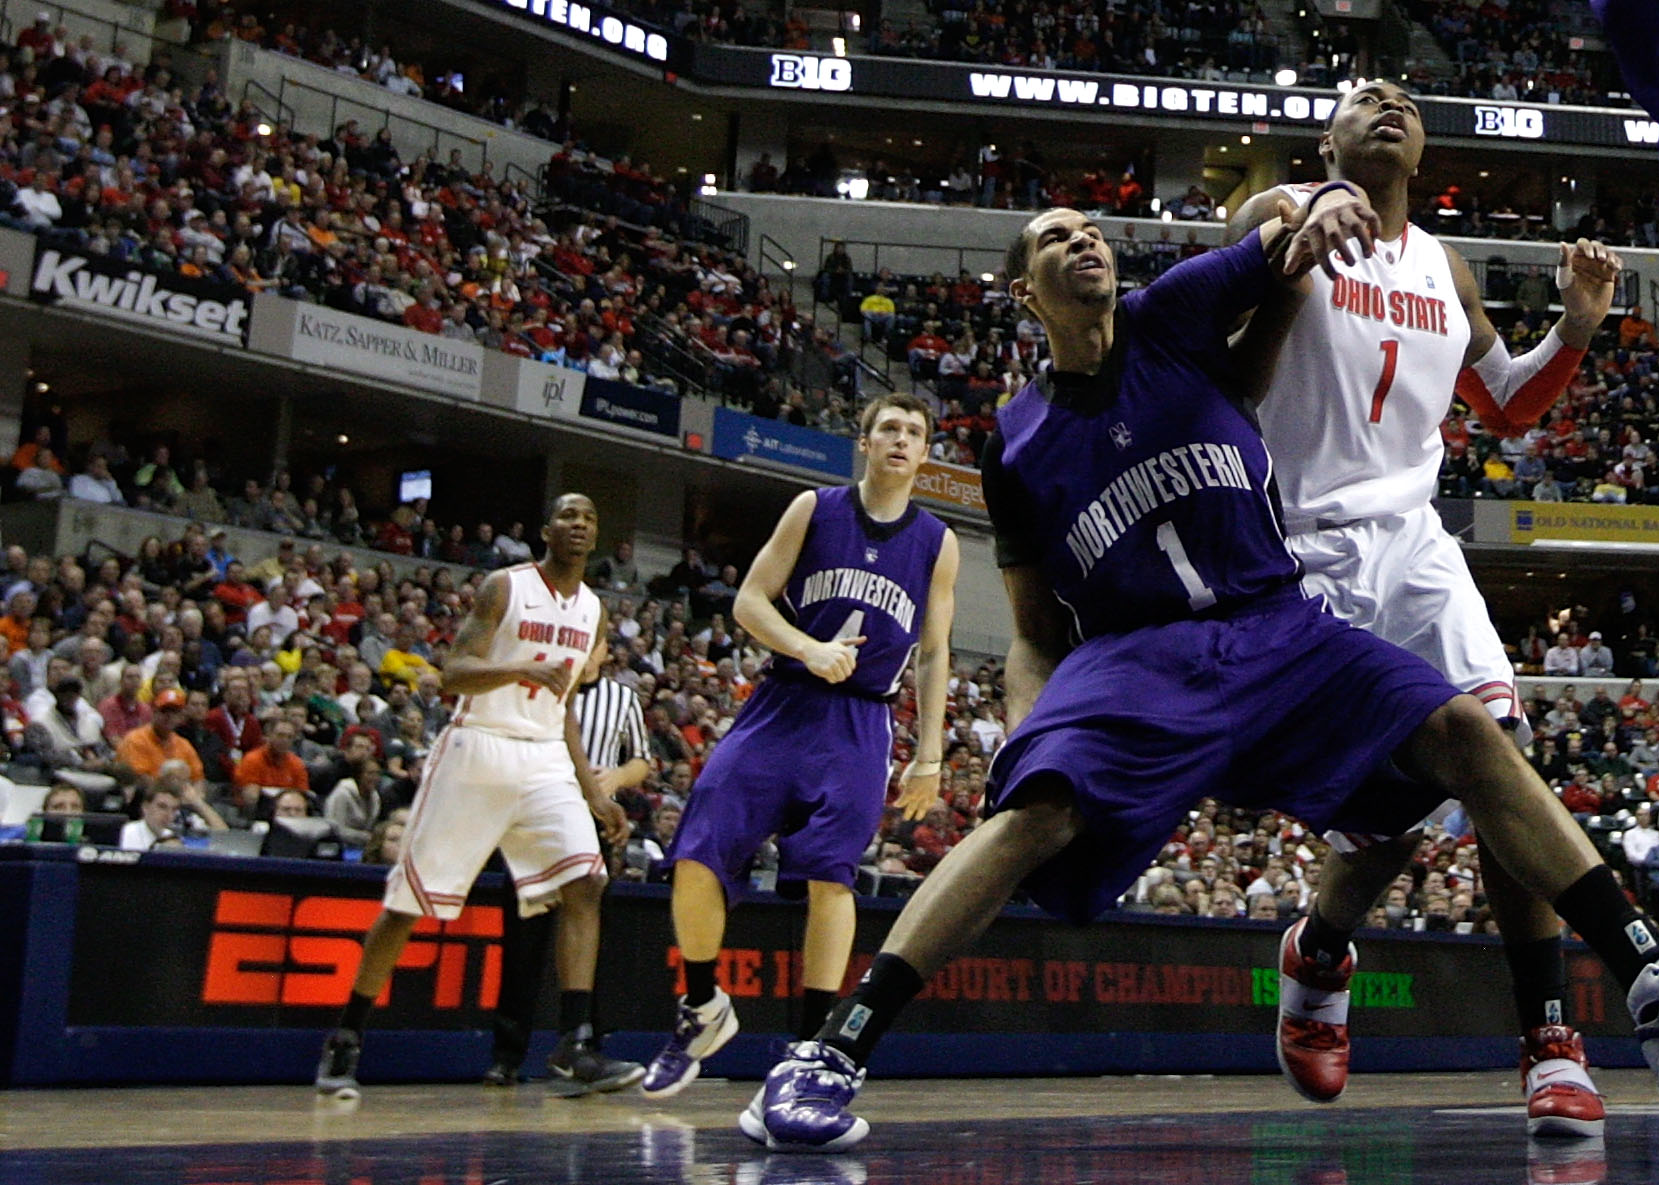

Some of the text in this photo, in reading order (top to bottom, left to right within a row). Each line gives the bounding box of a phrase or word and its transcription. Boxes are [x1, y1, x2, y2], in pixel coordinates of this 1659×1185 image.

[34, 249, 249, 337] Kwikset
[1332, 273, 1448, 337] OHIO STATE
[345, 327, 403, 357] SAPPER
[404, 341, 419, 363] &
[422, 344, 478, 376] MILLER
[1369, 339, 1399, 425] 1
[542, 376, 566, 407] ipl
[1066, 443, 1253, 579] NORTHWESTERN
[1536, 516, 1567, 529] OLD
[1569, 517, 1638, 530] NATIONAL
[1157, 521, 1217, 612] 1
[801, 568, 917, 634] NORTHWESTERN
[518, 620, 590, 652] OHIO STATE
[1044, 961, 1088, 1003] OF
